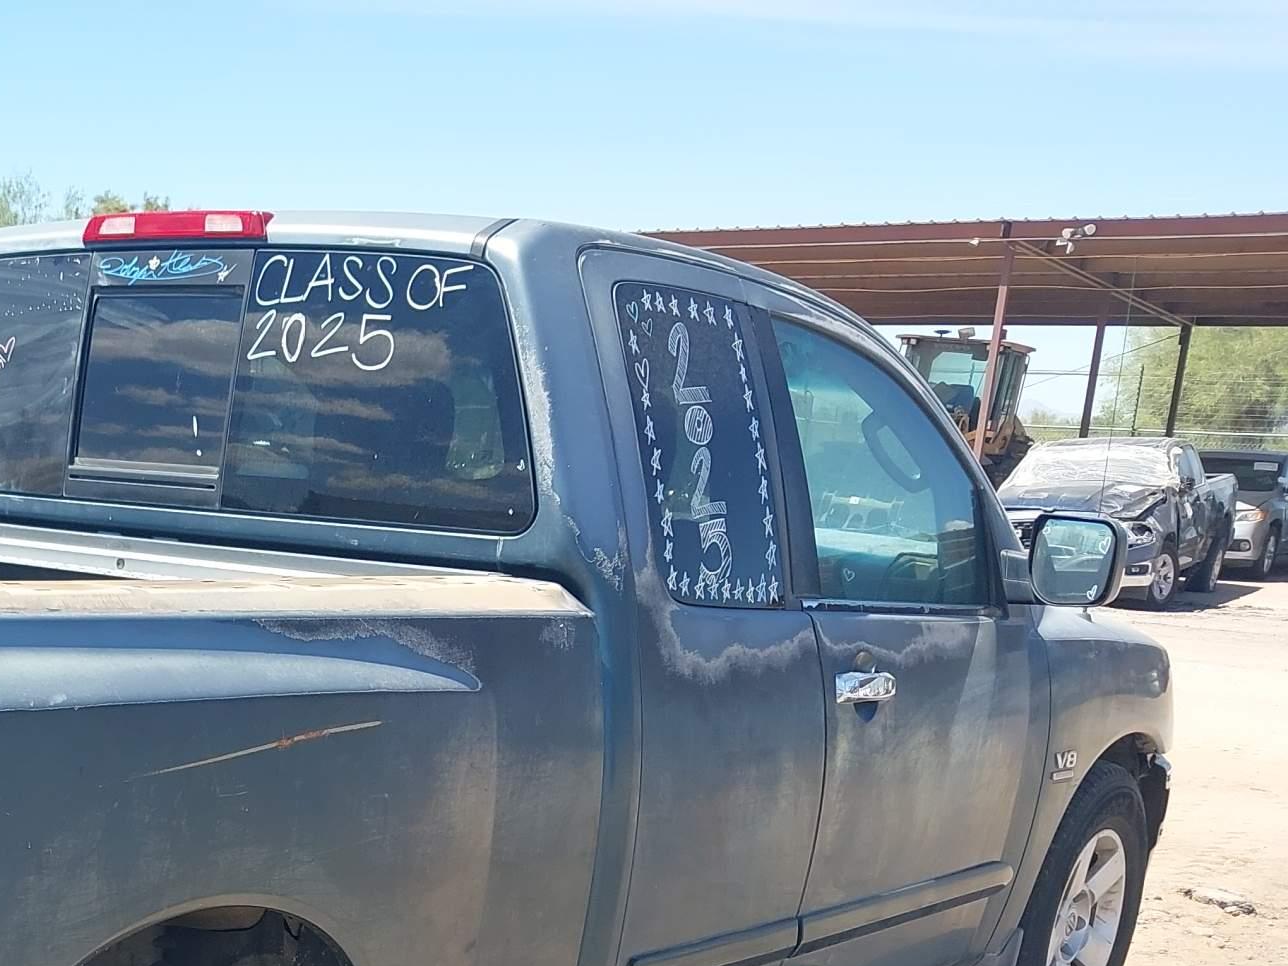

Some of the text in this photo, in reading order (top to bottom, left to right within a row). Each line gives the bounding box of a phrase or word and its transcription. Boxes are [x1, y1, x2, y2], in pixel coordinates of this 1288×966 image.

[255, 253, 397, 309] CLASS
[407, 264, 474, 310] OF
[247, 308, 395, 371] 2025
[668, 321, 733, 584] 2025
[1055, 751, 1077, 769] V8
